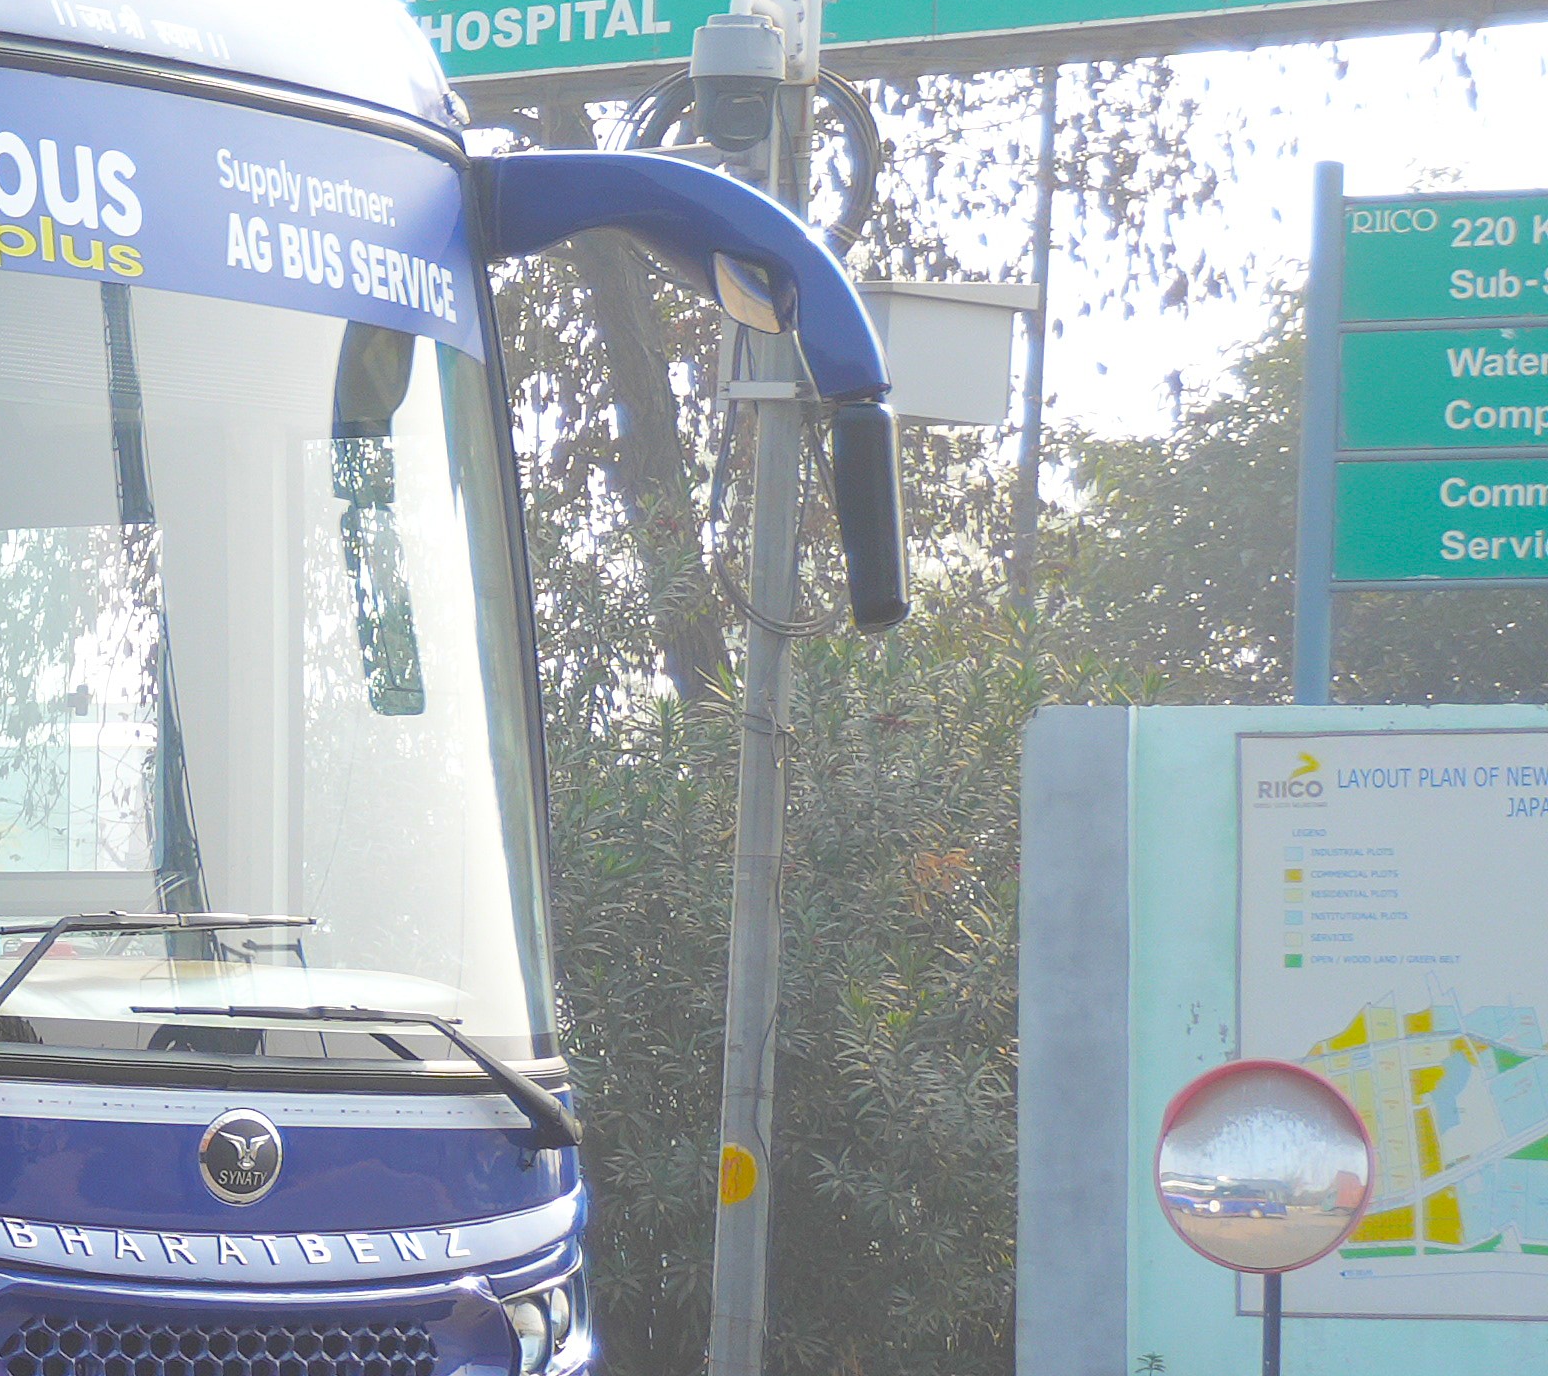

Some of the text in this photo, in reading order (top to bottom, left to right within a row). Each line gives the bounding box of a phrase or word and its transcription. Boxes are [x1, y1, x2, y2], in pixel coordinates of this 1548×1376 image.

[217, 148, 397, 228] Supply partner:
[1351, 208, 1439, 233] RIICO
[1450, 215, 1518, 247] 220
[227, 213, 456, 323] AG BUS SERVICE
[1449, 267, 1548, 299] Sub-
[1447, 346, 1548, 378] Water
[1440, 529, 1548, 561] Servi
[1257, 780, 1324, 799] RIICO
[1337, 765, 1548, 789] LAYOUT PLAN OF NEW
[1310, 869, 1399, 879] COMMERCIAL PLOTS
[1311, 889, 1398, 898] RESIDENTIAL PLOTS
[219, 1170, 267, 1185] SYNATY
[3, 1217, 473, 1261] BHARATBENZ
